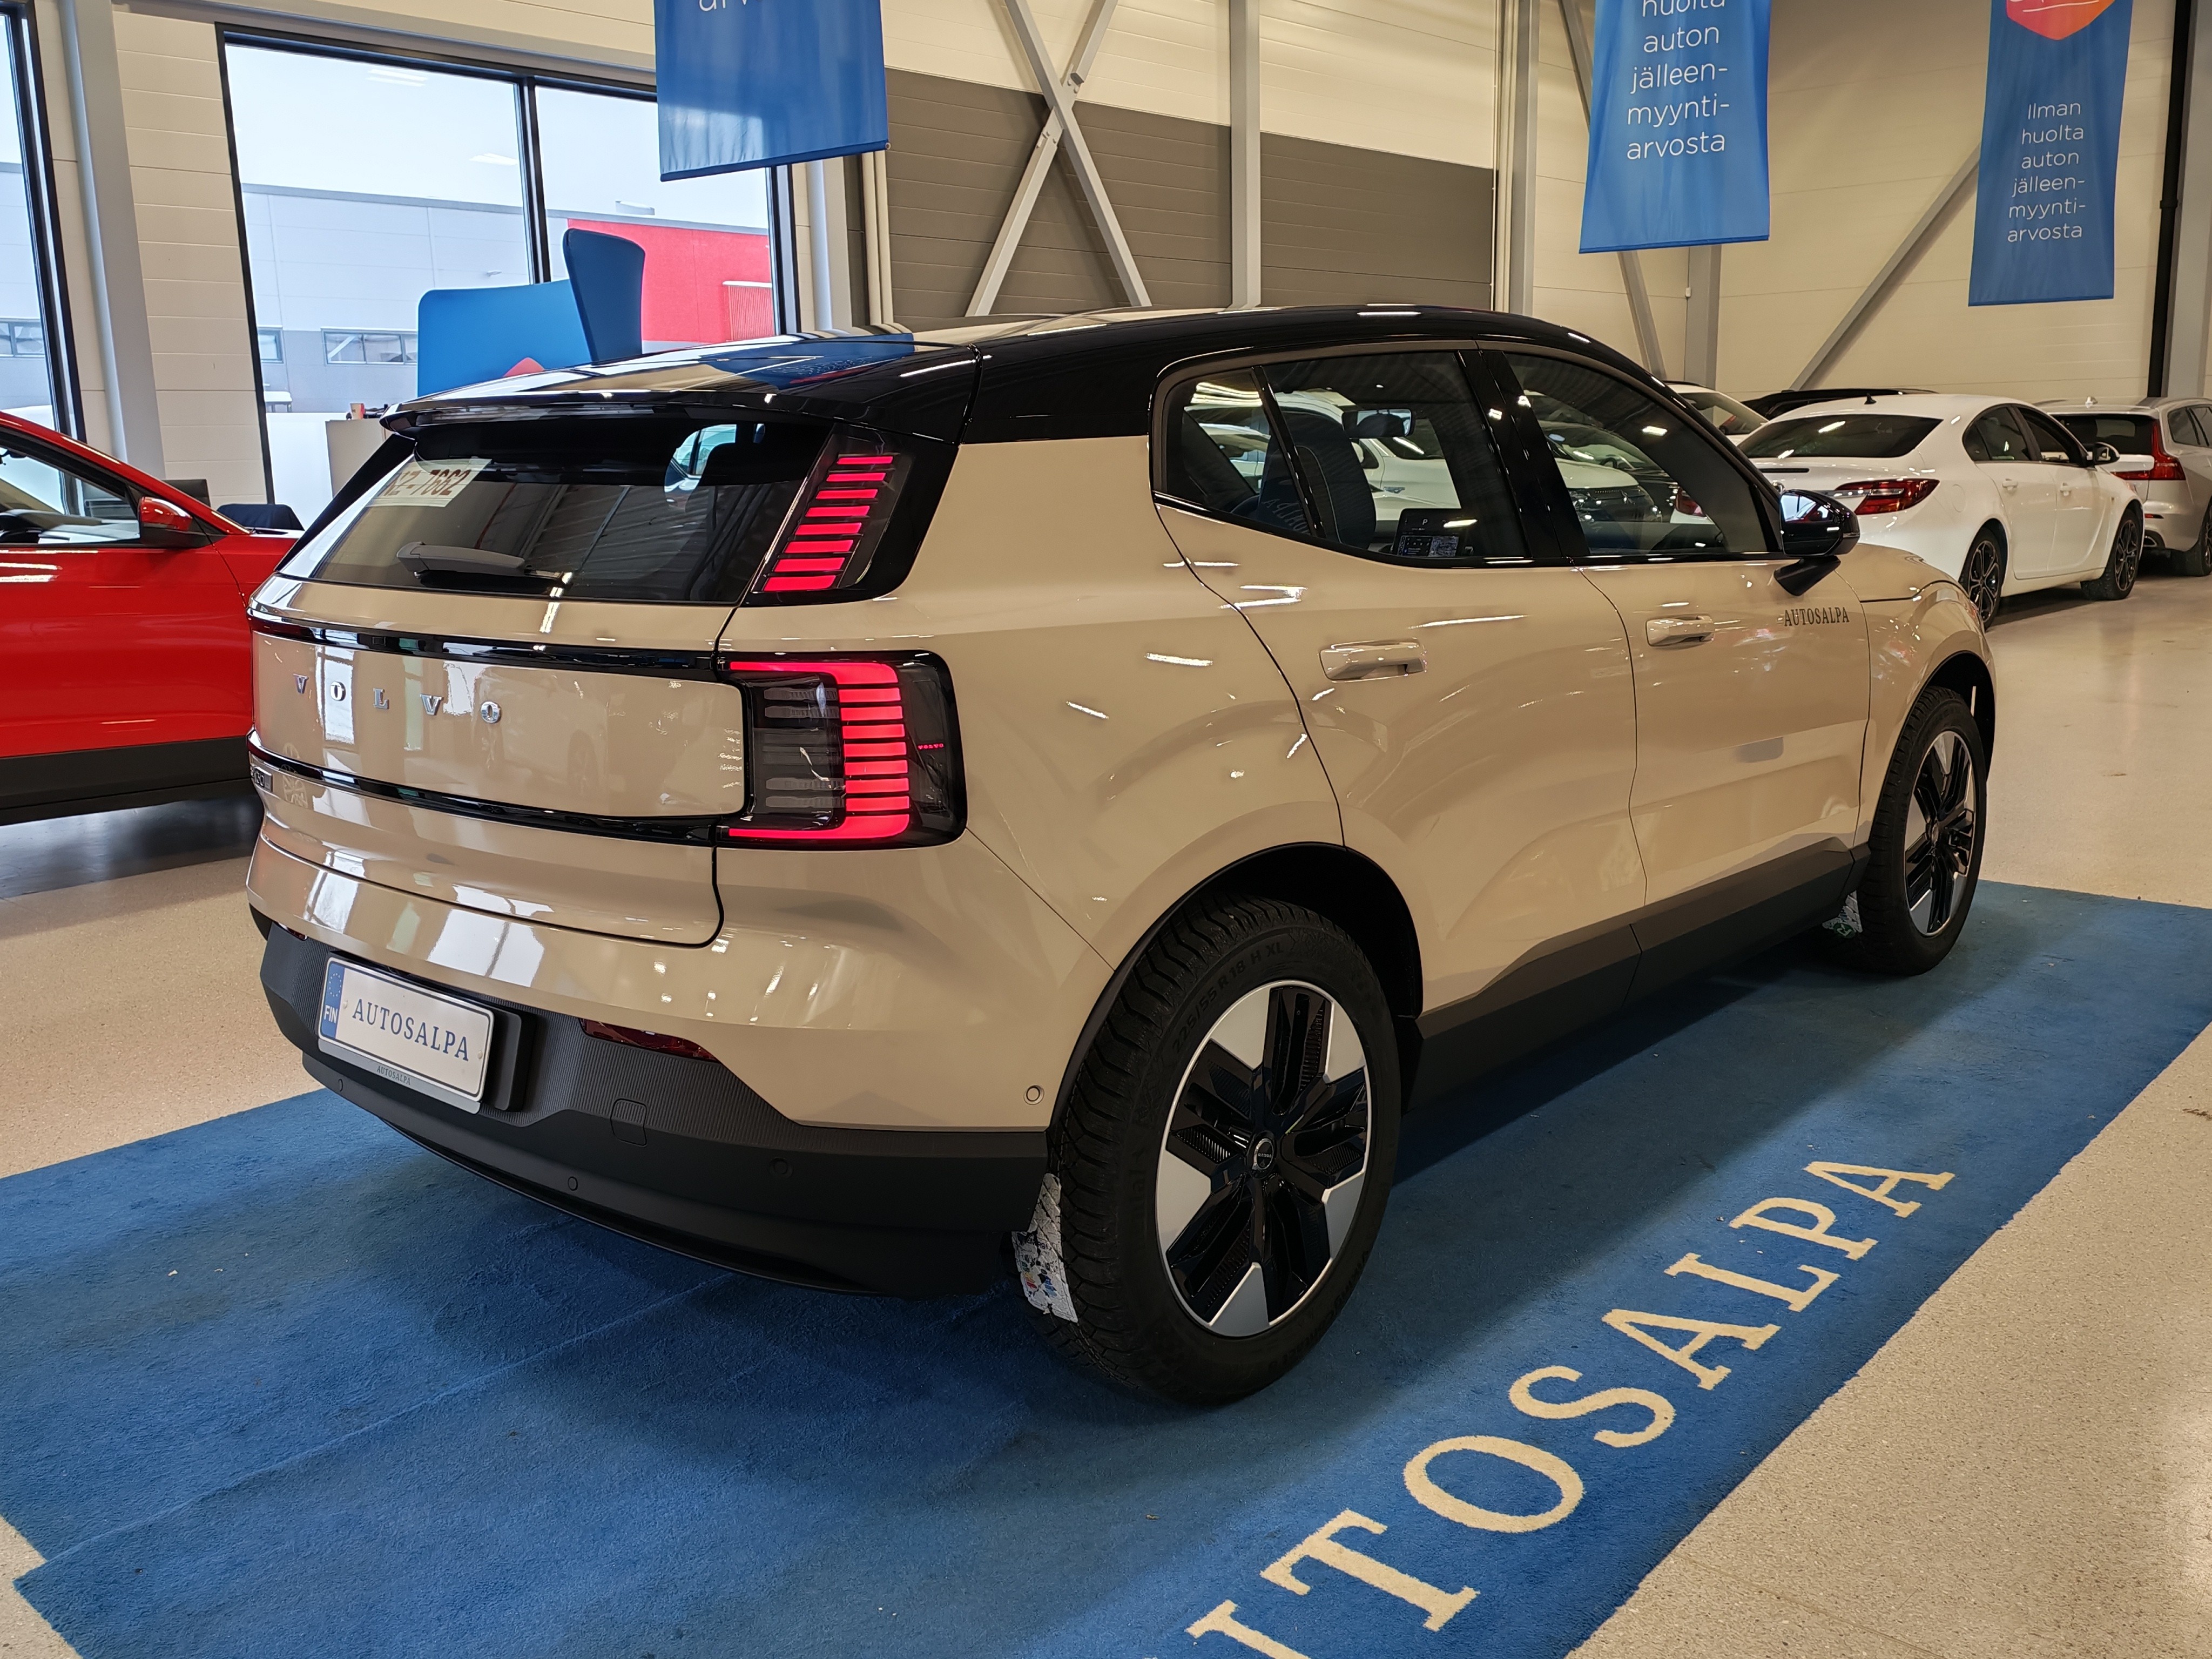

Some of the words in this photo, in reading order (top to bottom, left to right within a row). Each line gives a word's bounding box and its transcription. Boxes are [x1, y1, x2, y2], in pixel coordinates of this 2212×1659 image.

[1643, 26, 1719, 53] auton
[1630, 62, 1728, 95] jälleen-
[1627, 93, 1730, 128] myynti-
[2027, 101, 2081, 120] Ilman
[1627, 131, 1725, 160] arvosta
[2021, 124, 2084, 145] huolta
[2021, 150, 2079, 169] auton
[2011, 174, 2085, 198] jälleen-
[2008, 198, 2086, 220] myynti-
[2007, 222, 2083, 243] arvosta
[1784, 606, 1850, 626] AUTOSALPA
[293, 673, 502, 724] VOLVO
[324, 1004, 339, 1024] FIN
[352, 999, 469, 1062] AUTOSALPA
[376, 1065, 411, 1085] AUTOSALPA
